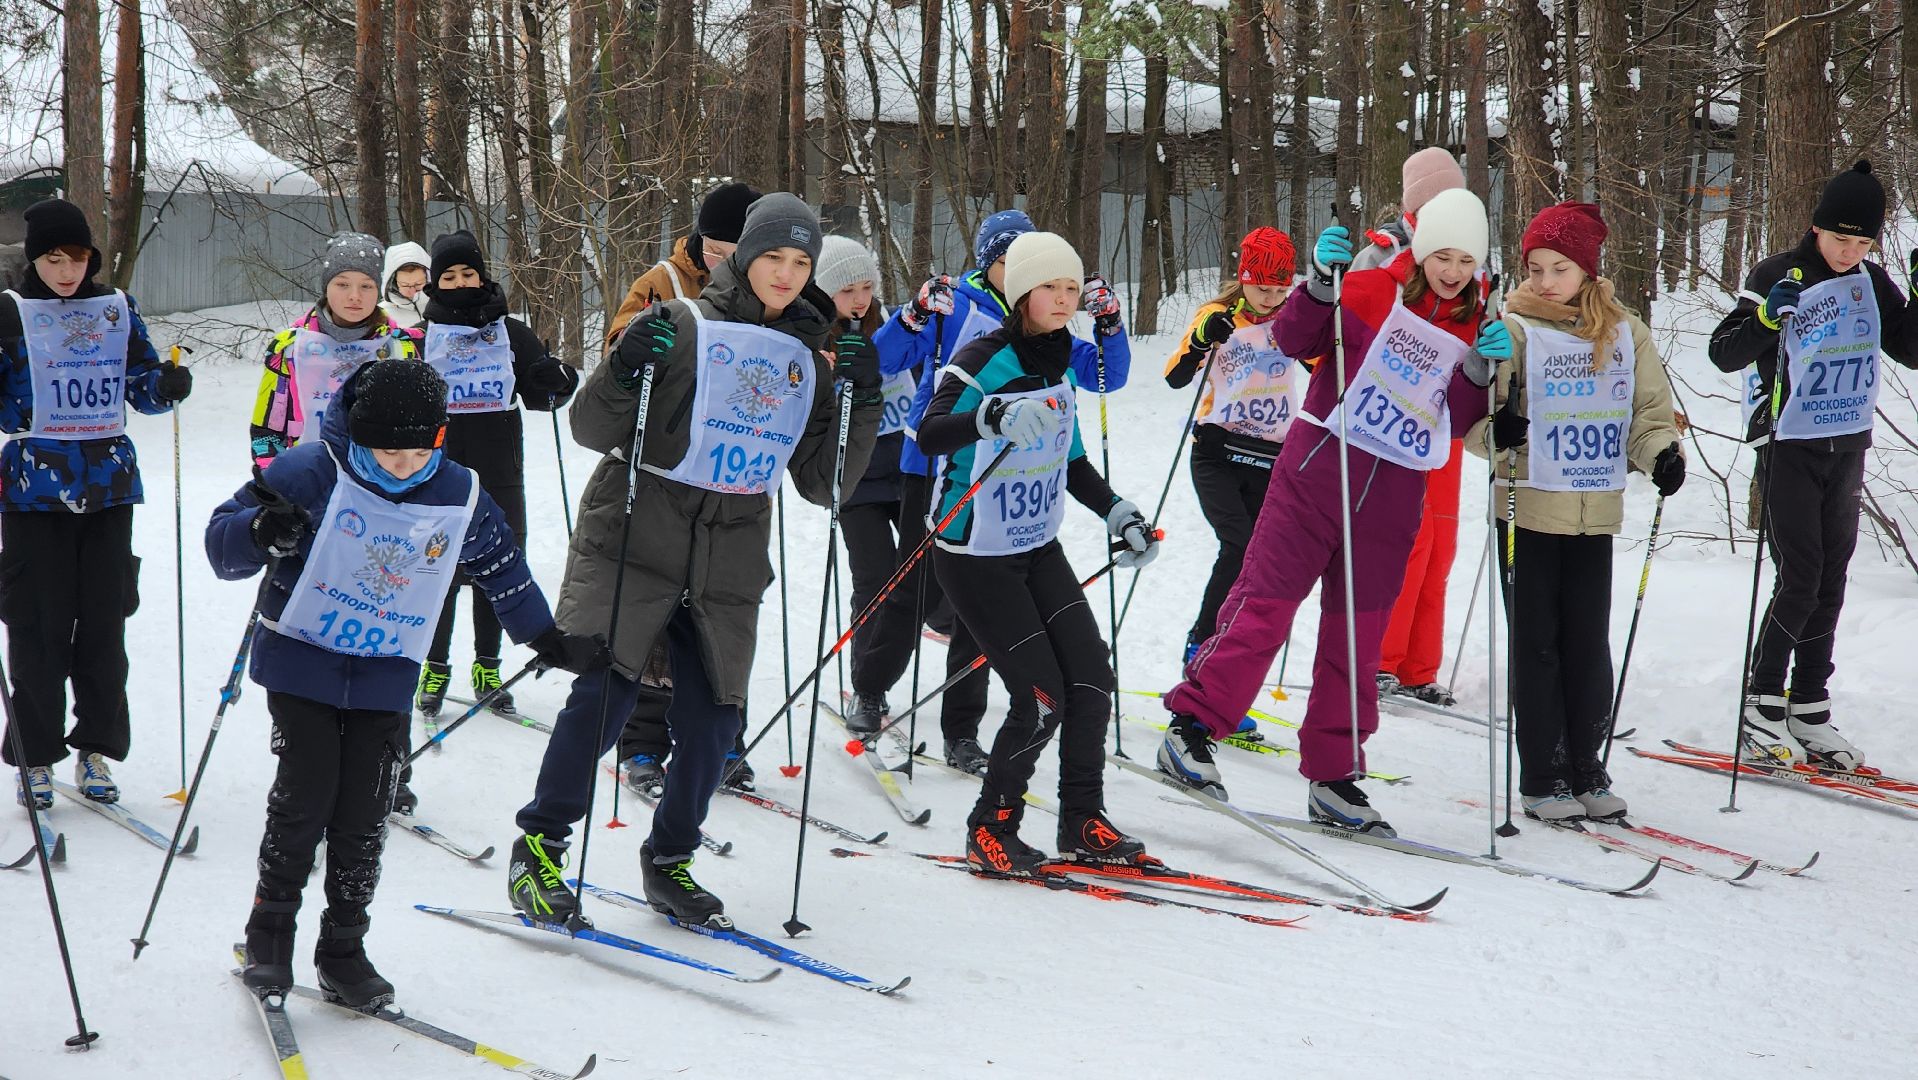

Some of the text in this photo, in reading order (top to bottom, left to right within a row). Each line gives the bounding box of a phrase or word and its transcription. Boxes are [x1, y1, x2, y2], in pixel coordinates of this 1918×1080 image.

[1792, 296, 1838, 329] ЛЫЖНЯ
[1796, 307, 1840, 339] РОССИИ
[1218, 343, 1254, 366] ЛЫЖНЯ
[1392, 328, 1439, 361] ЛЫЖНЯ
[1222, 352, 1258, 376] РОССИИ
[1386, 337, 1433, 373] РОССИИ
[1544, 353, 1594, 366] ЛЫЖНЯ
[741, 356, 780, 376] ЛЫЖНЯ
[1380, 349, 1423, 386] 2023
[1797, 356, 1875, 397] 2773
[51, 376, 121, 408] 10657
[1545, 381, 1595, 397] 2023
[638, 384, 651, 427] NORDWAY
[1802, 395, 1868, 412] МОСКОВСКАЯ
[732, 406, 772, 424] РОССИИ
[840, 400, 850, 442] NORDWAY
[1354, 384, 1431, 458] 13789
[1814, 411, 1860, 424] ОБЛАСТЬ
[1572, 478, 1610, 488] ОБЛАСТЬ
[372, 534, 416, 554] ЛЫЖНЯ
[1160, 777, 1190, 794] NORDWAY
[1771, 770, 1810, 784] ATOMIC
[1832, 773, 1876, 787] ATOMIC
[1322, 828, 1354, 840] NORDWAY
[510, 862, 528, 882] TREK
[1103, 865, 1144, 876] ROSSIGNOL
[688, 924, 714, 937] NORDWAY
[789, 954, 854, 978] NORDWAY
